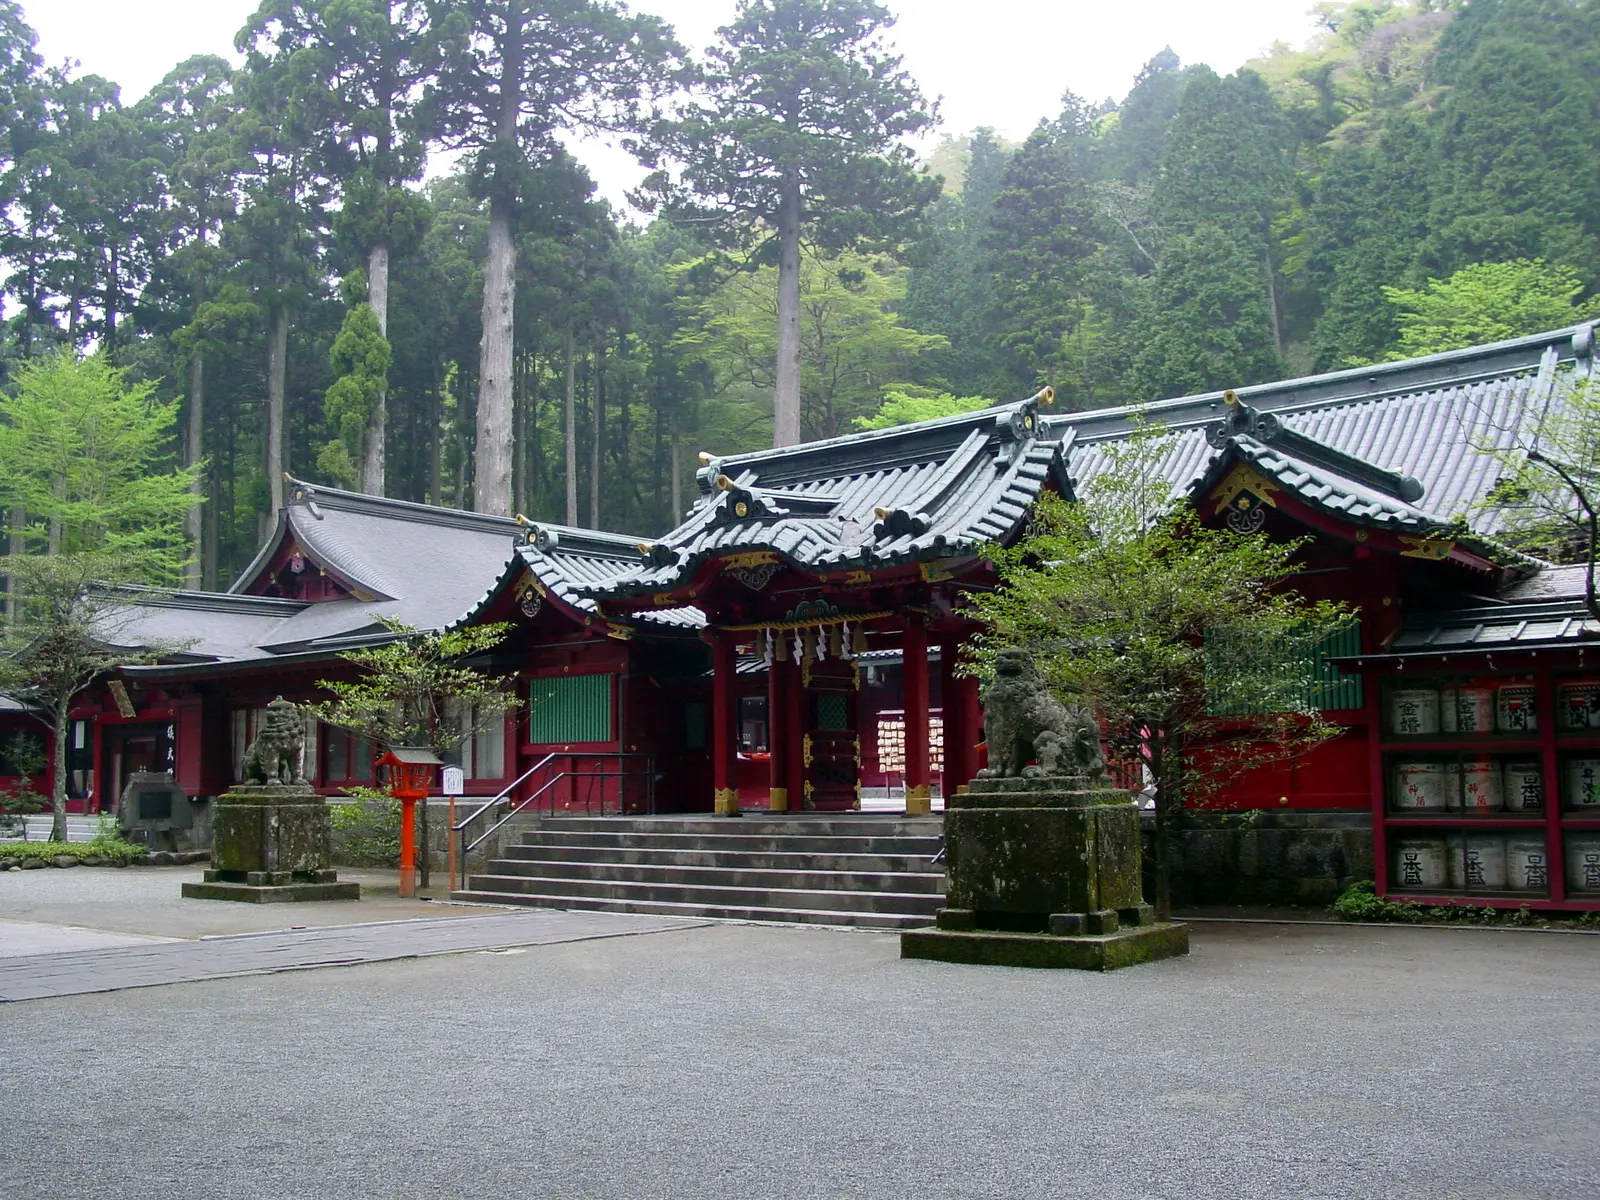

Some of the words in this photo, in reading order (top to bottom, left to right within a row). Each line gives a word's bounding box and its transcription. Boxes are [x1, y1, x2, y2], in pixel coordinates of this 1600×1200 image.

[1399, 702, 1420, 732] 金婚
[1520, 775, 1541, 808] 日本盛
[1581, 769, 1596, 804] 丹沢山
[1403, 853, 1423, 885] 日本盛
[1524, 855, 1548, 888] 日本盛
